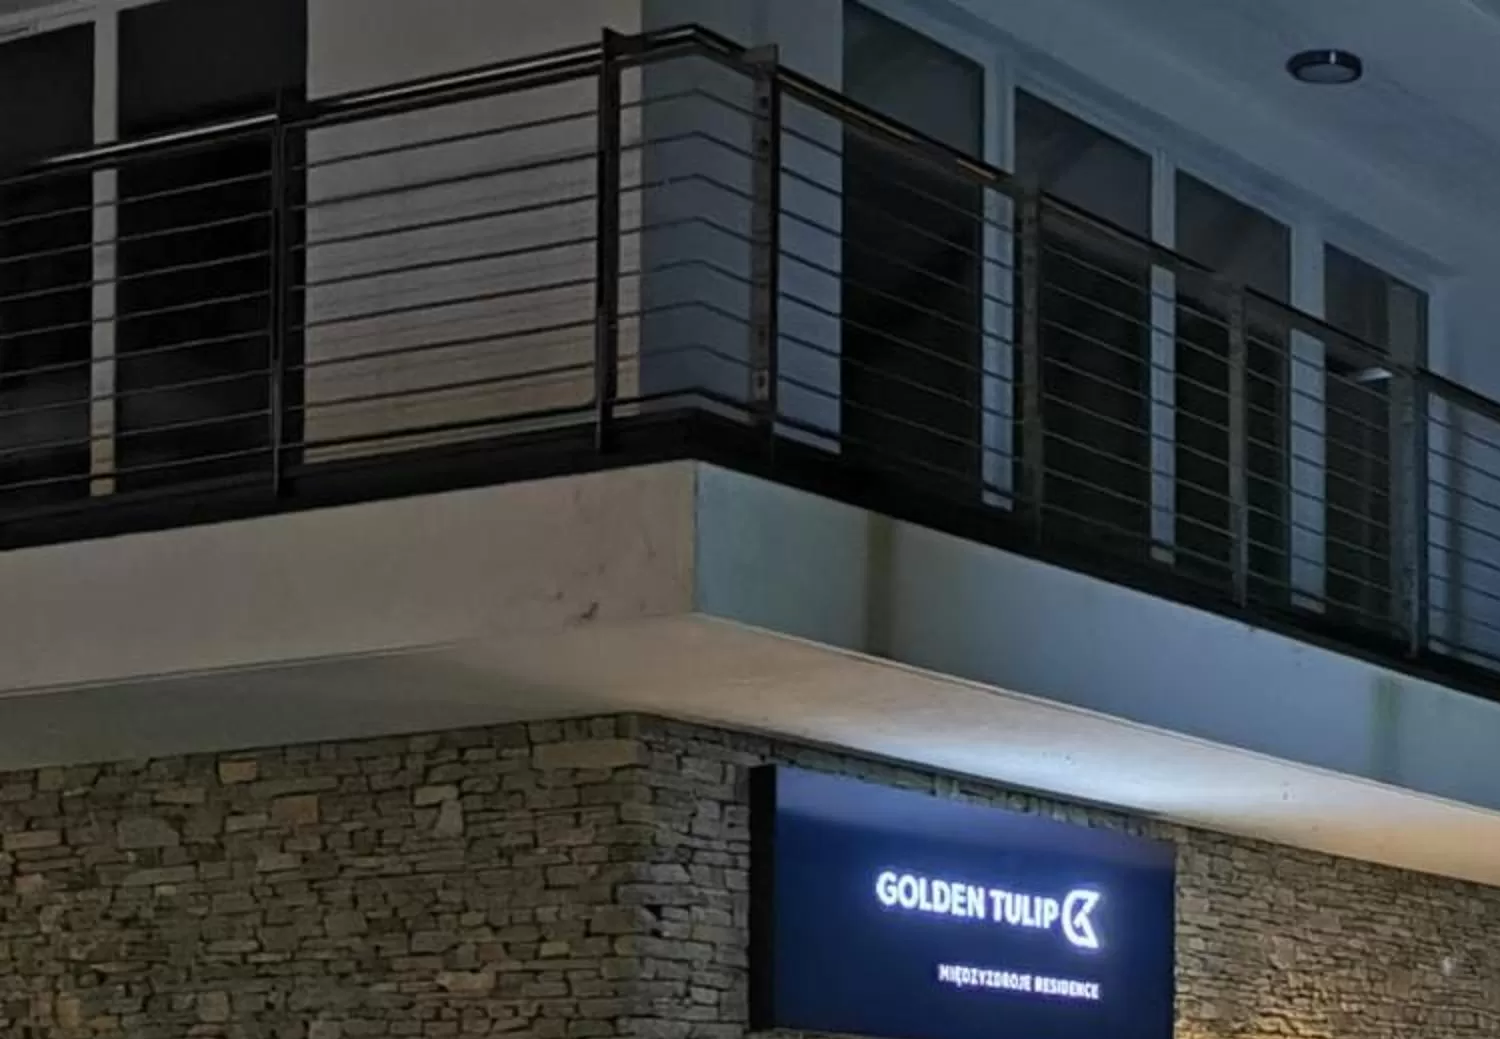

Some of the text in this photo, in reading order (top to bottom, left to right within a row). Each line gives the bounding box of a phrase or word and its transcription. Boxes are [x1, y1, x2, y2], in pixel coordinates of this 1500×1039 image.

[876, 871, 1060, 929] GOLDEN TULIP
[937, 963, 1100, 999] MIĘDZYZDROJE RESIDENCE
